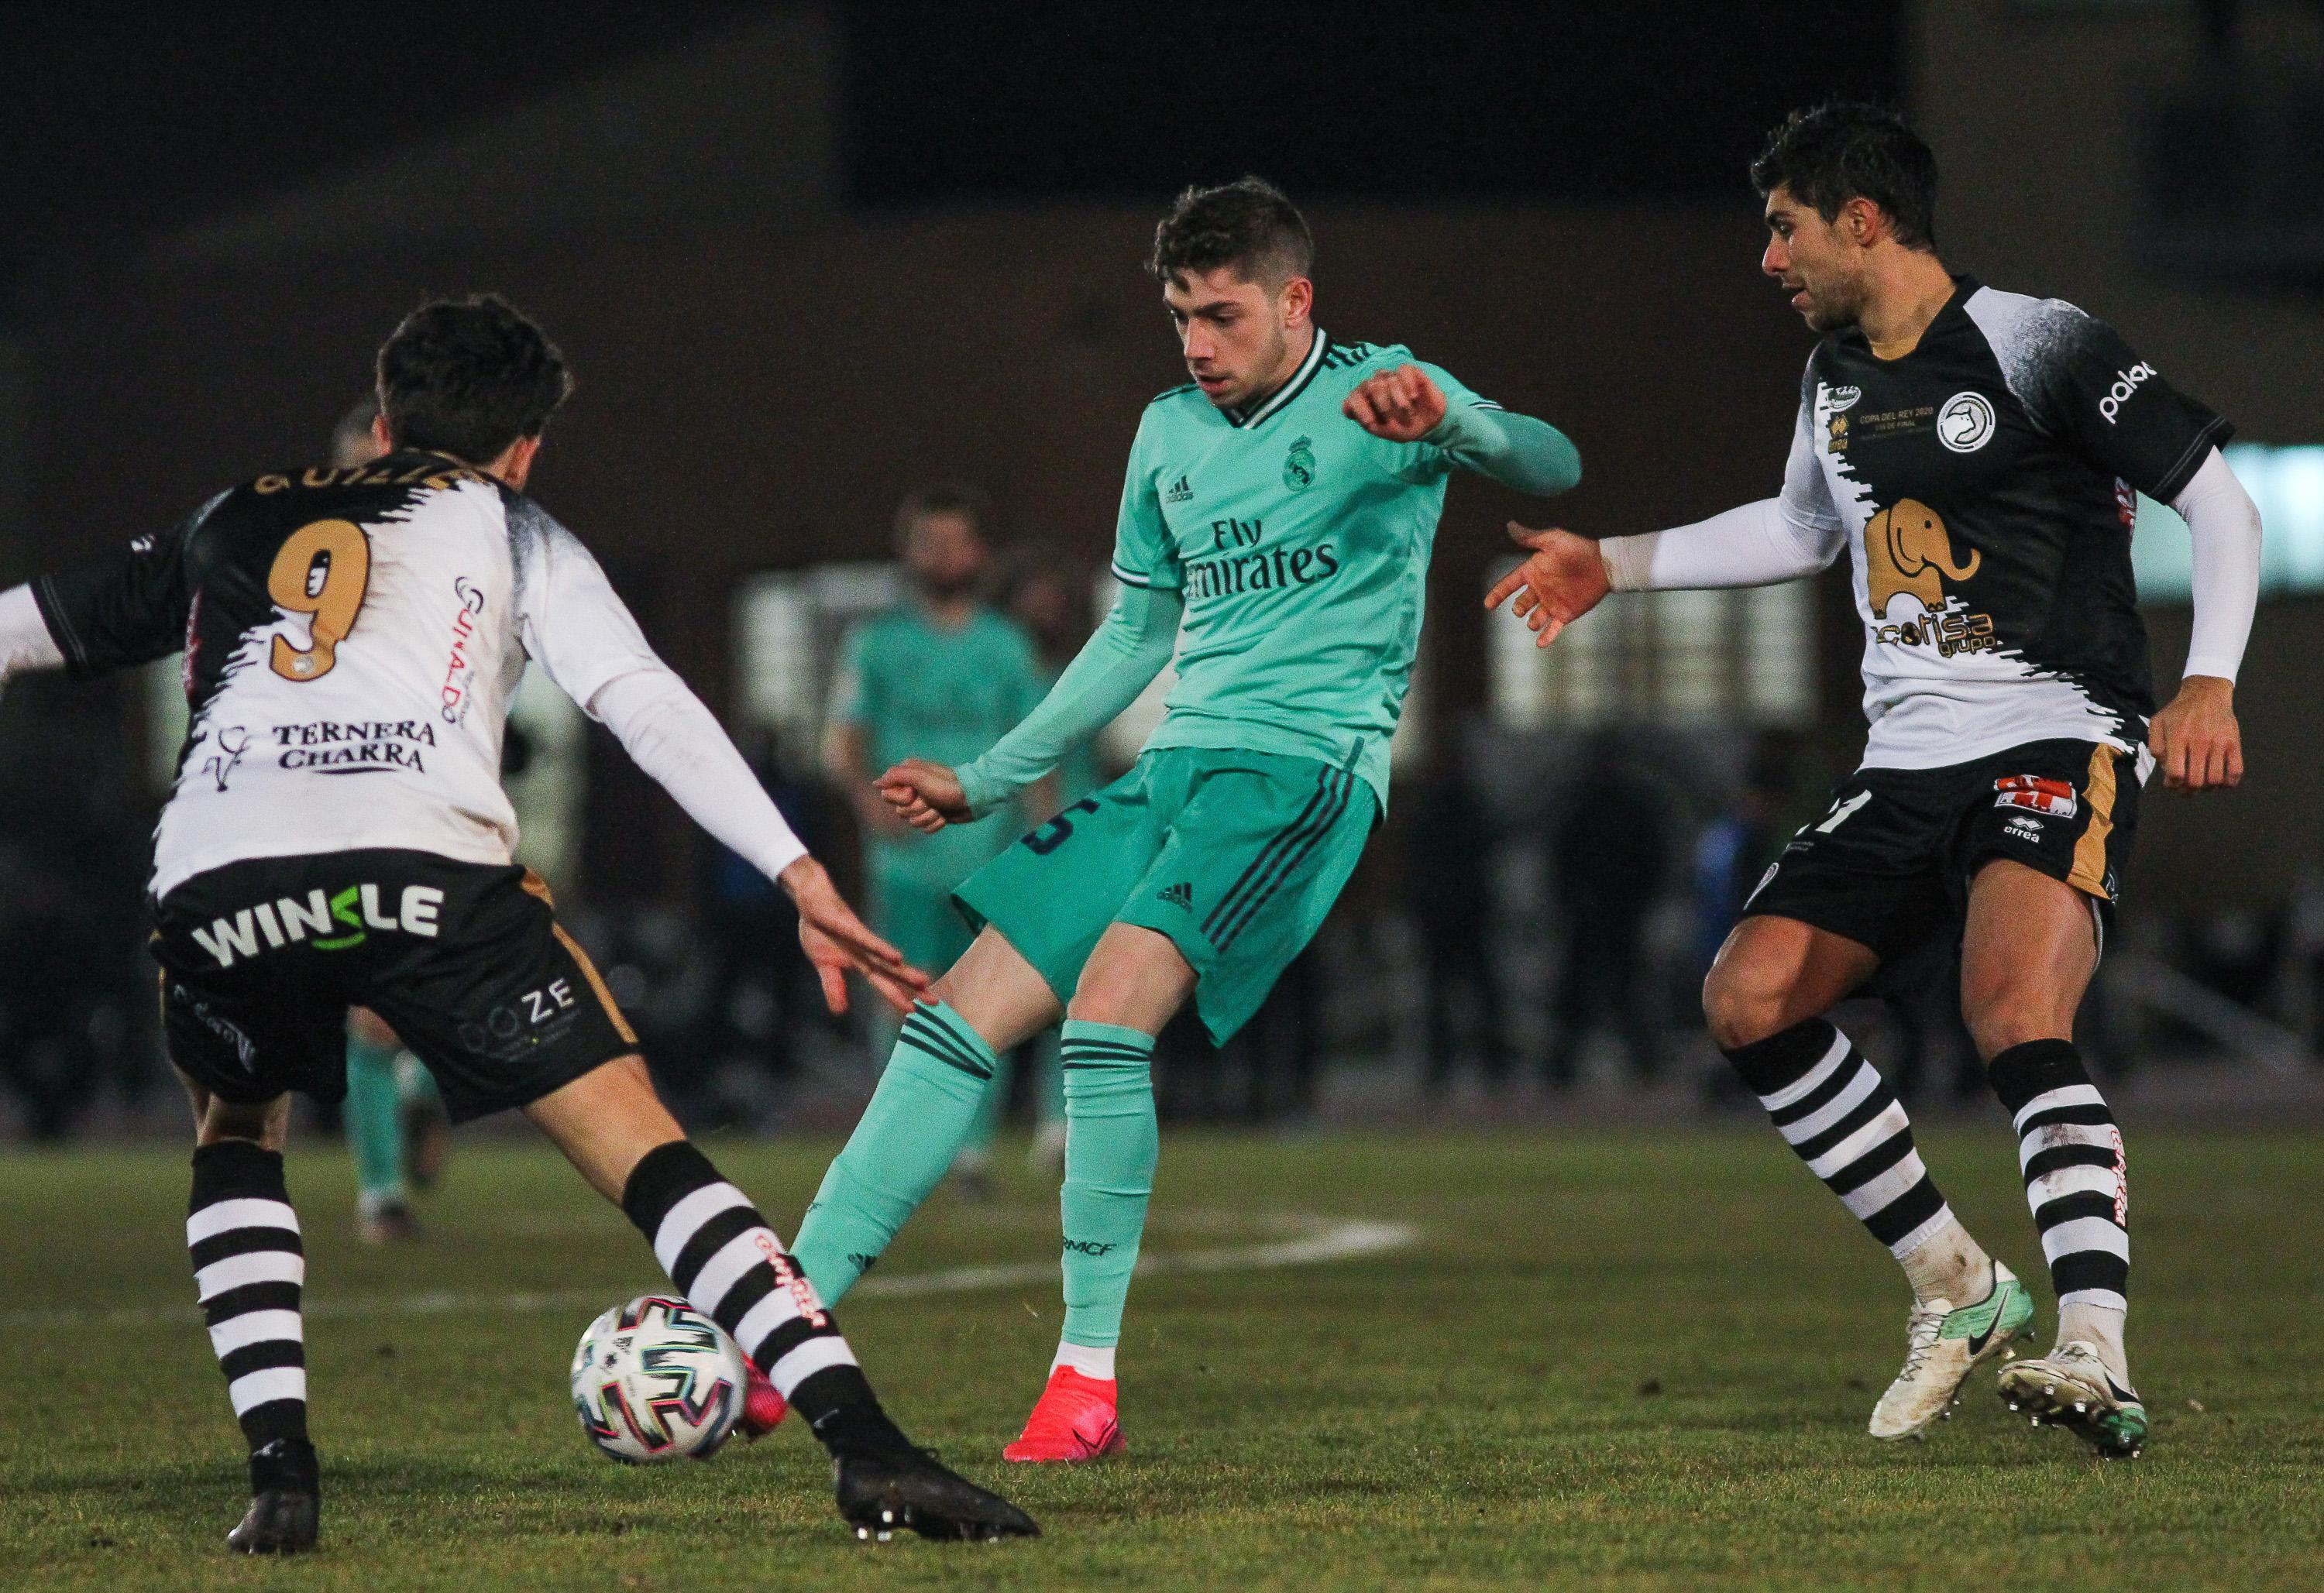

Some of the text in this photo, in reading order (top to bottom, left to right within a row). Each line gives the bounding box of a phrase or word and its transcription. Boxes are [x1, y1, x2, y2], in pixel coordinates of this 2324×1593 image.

[1211, 517, 1263, 551] Fly
[267, 518, 372, 682] 9
[1938, 635, 1996, 659] grupo
[271, 719, 437, 747] TERNERA
[1019, 798, 1101, 856] 5
